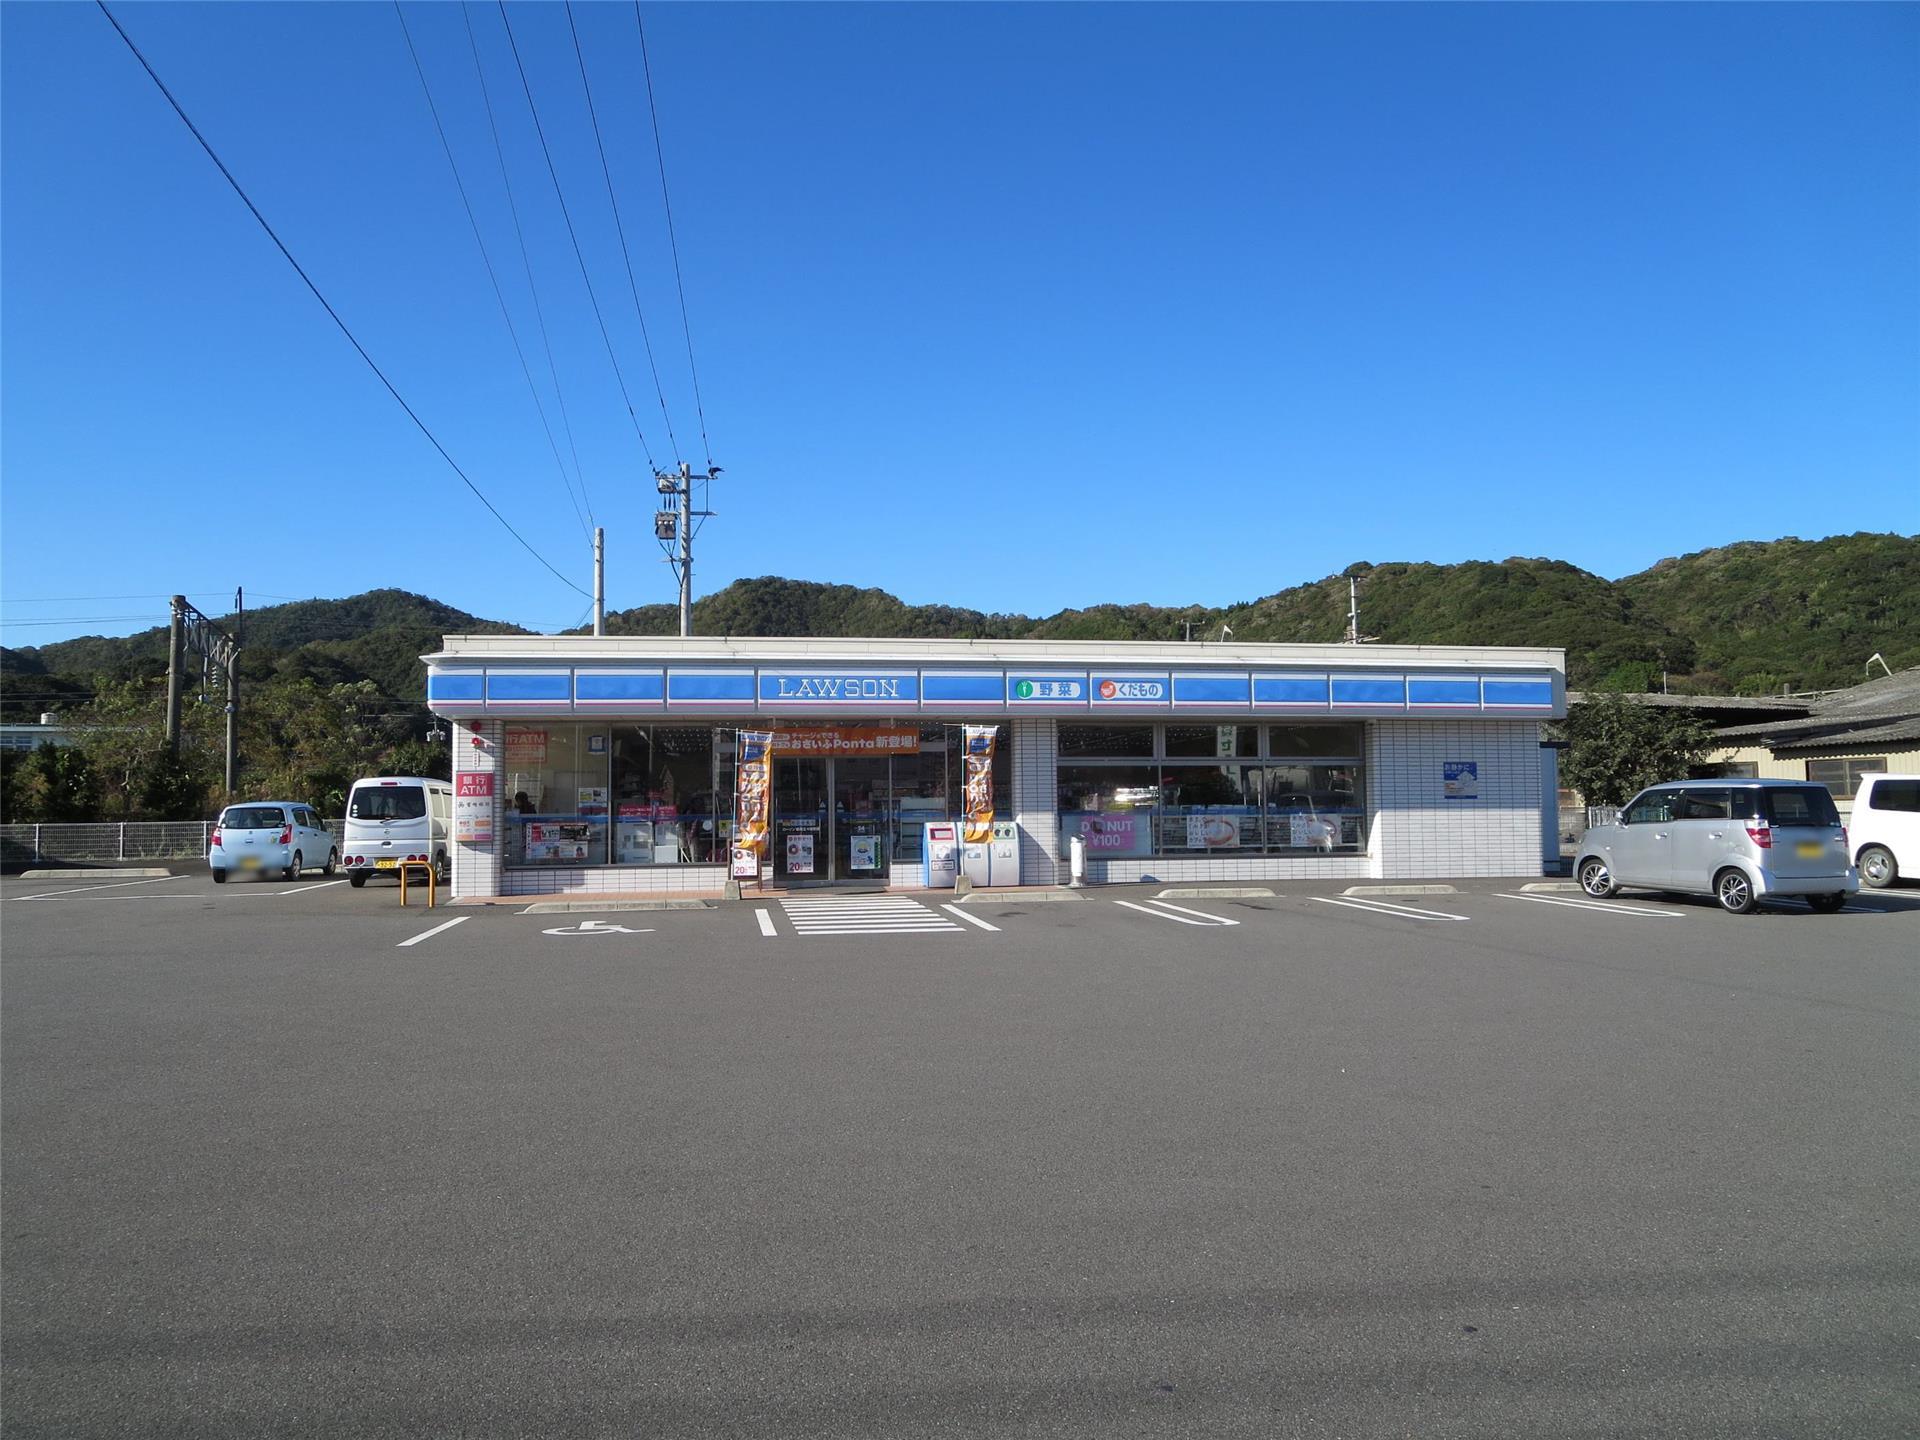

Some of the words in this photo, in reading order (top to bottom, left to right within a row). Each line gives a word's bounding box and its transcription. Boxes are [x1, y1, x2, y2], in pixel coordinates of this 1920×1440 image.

[778, 678, 898, 697] LAWSON
[1039, 682, 1072, 697] 野菜
[1118, 683, 1158, 697] くだもの
[463, 775, 487, 785] 銀行
[461, 785, 487, 795] ATM
[1092, 834, 1121, 847] ¥100
[789, 862, 800, 872] 20
